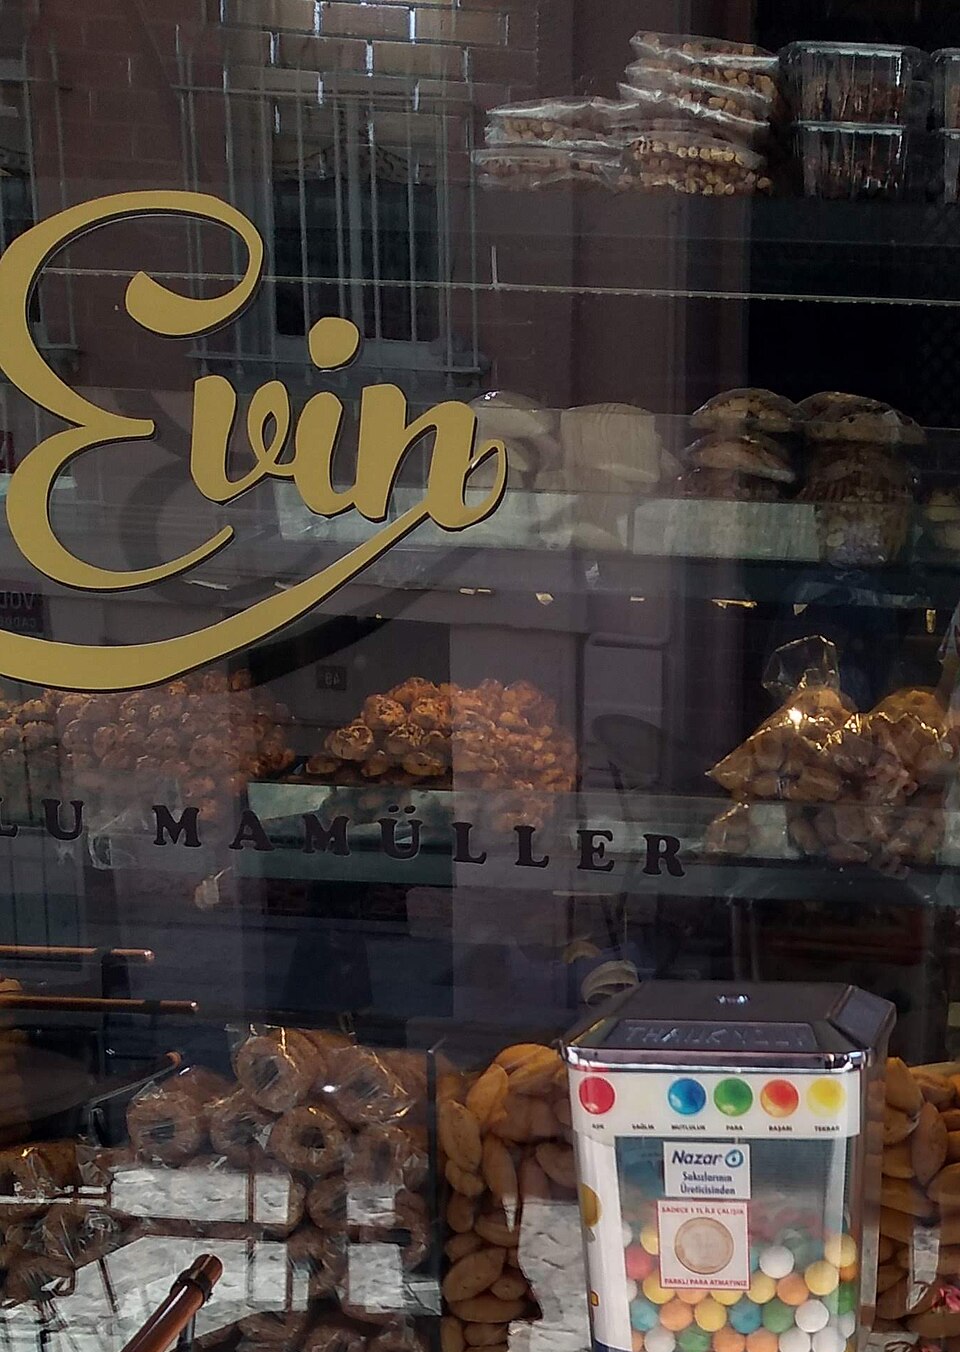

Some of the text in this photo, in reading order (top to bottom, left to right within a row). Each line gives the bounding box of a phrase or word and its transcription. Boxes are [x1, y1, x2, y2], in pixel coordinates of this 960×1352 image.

[0, 190, 507, 692] Evin
[152, 804, 687, 878] MAMÜLLER
[672, 1150, 722, 1165] Nazar
[680, 1181, 736, 1195] Üreticisinden
